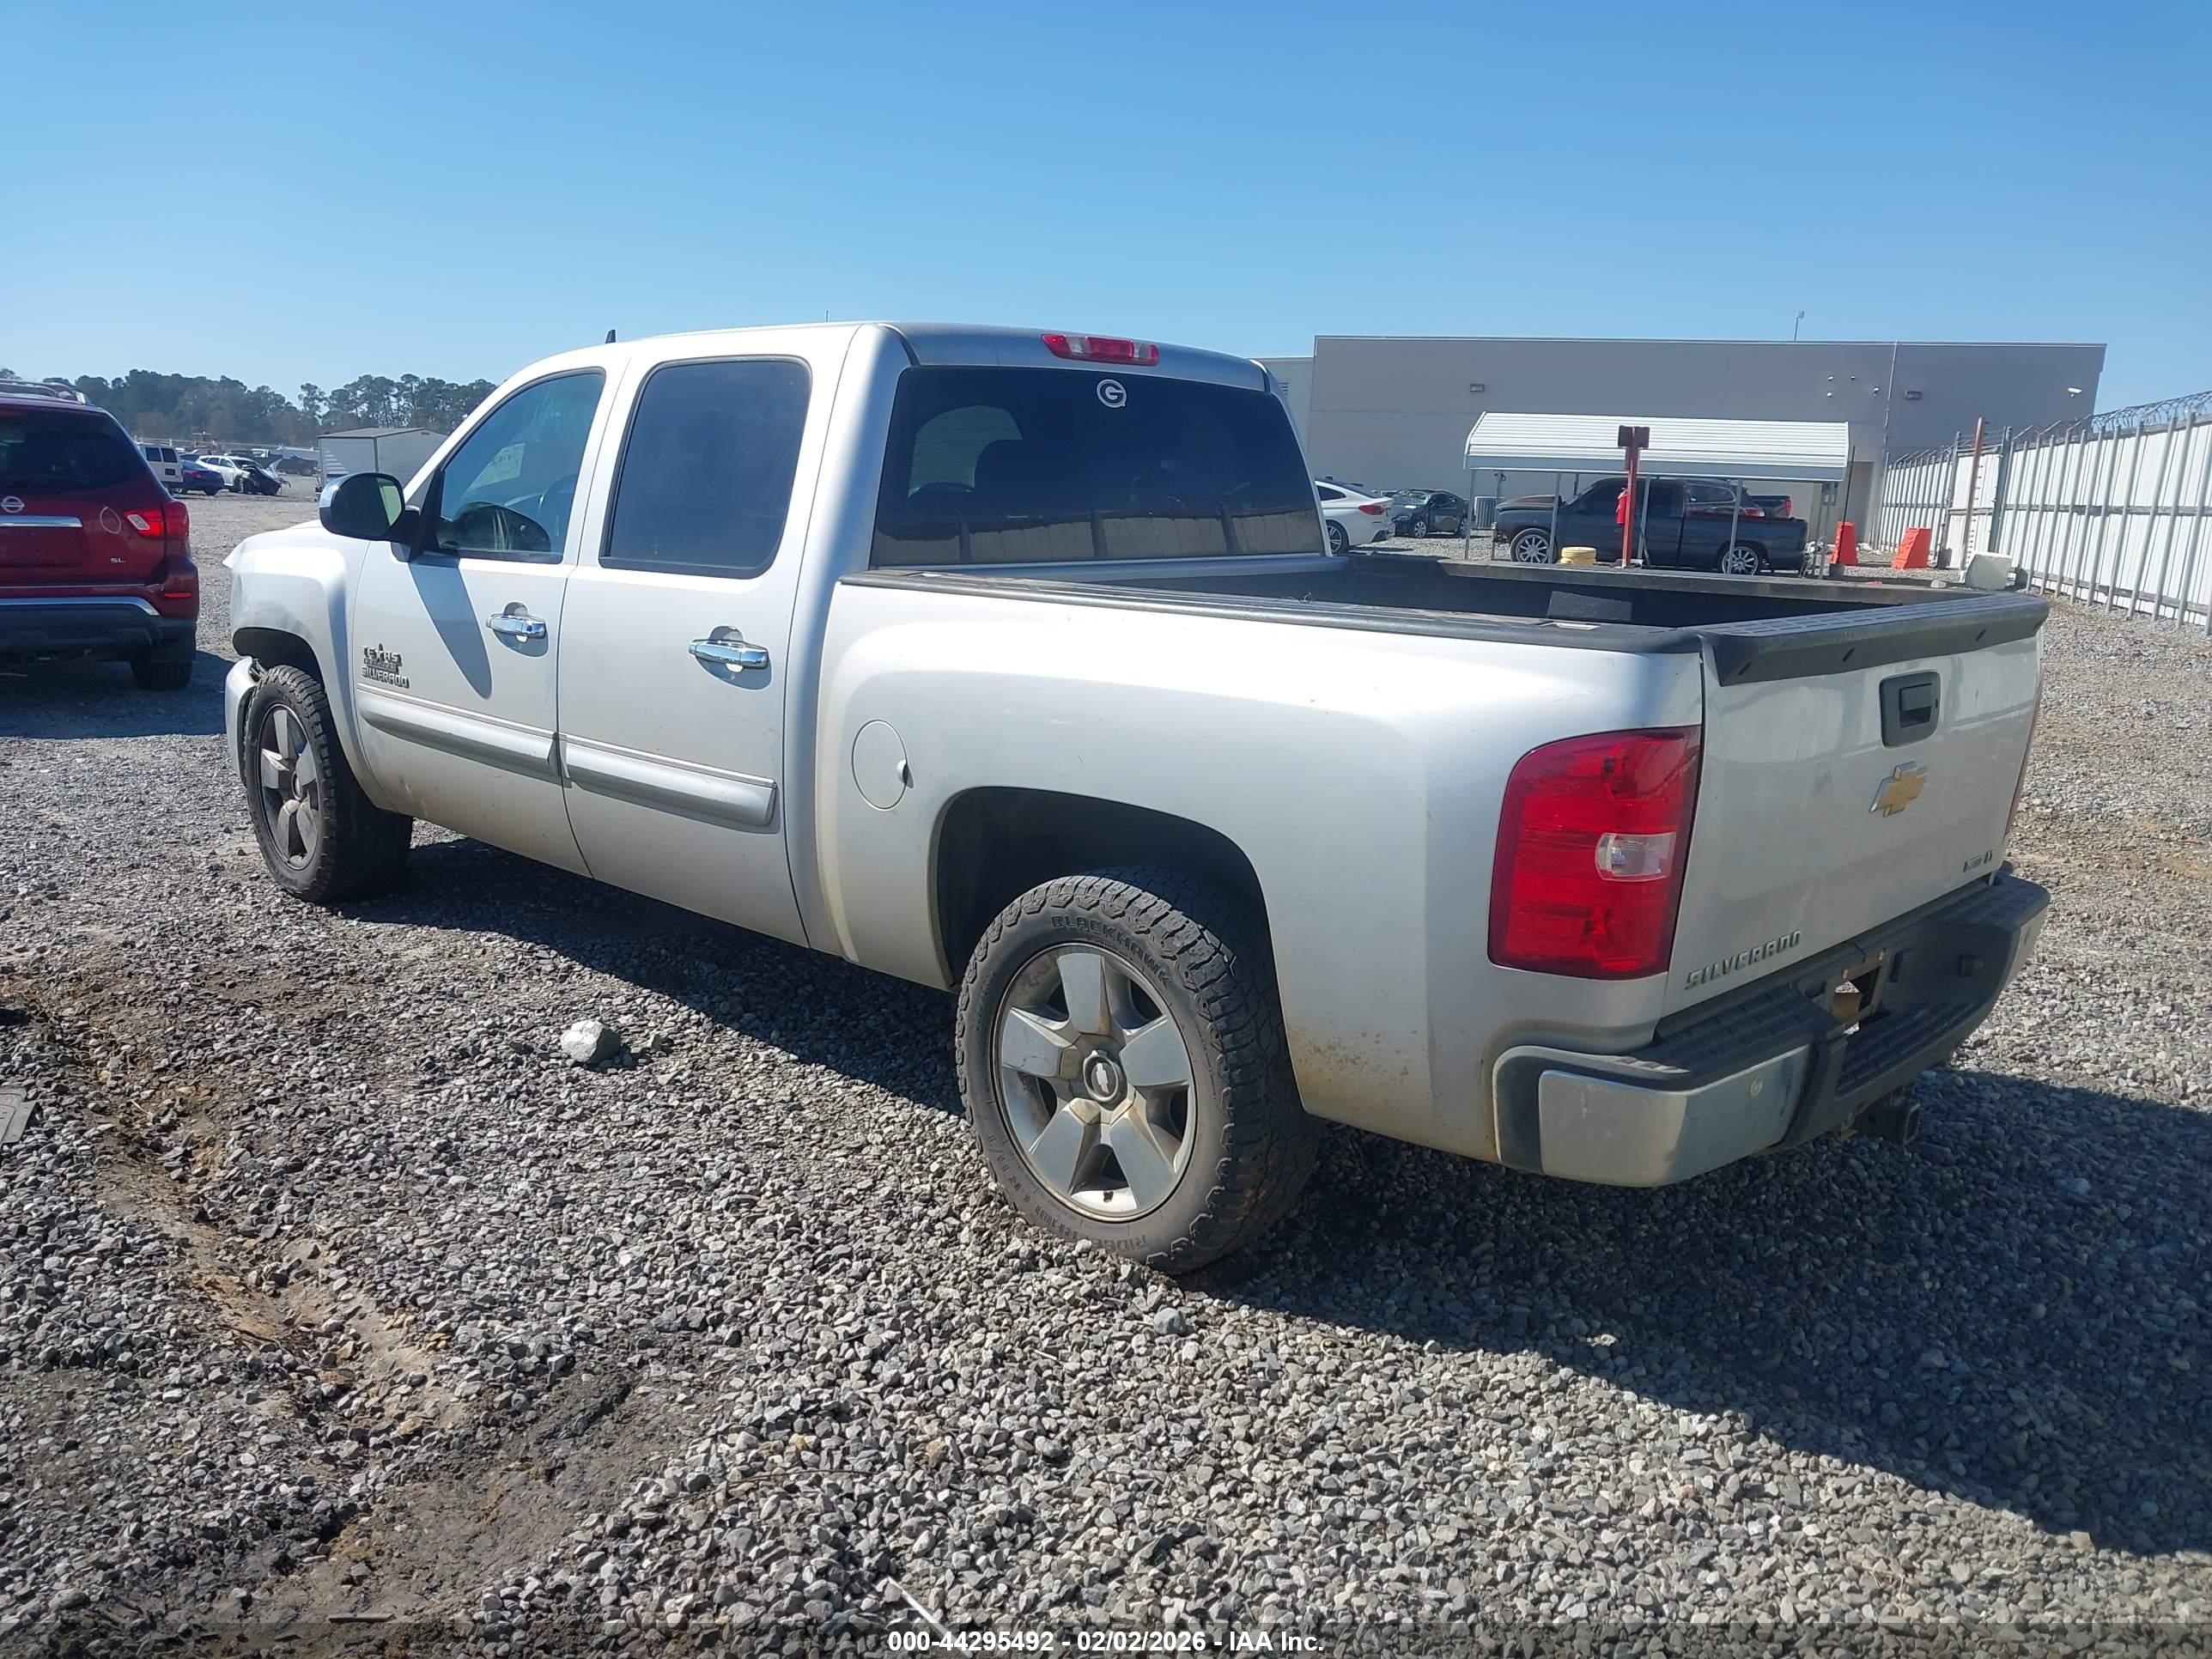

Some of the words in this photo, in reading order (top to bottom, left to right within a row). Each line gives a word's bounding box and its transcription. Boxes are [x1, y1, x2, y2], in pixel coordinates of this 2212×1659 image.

[363, 643, 403, 665] TEXAS
[362, 665, 410, 689] SILVERADO
[1050, 915, 1173, 990] BLACKHAWK
[1684, 929, 1802, 990] SILVERADO
